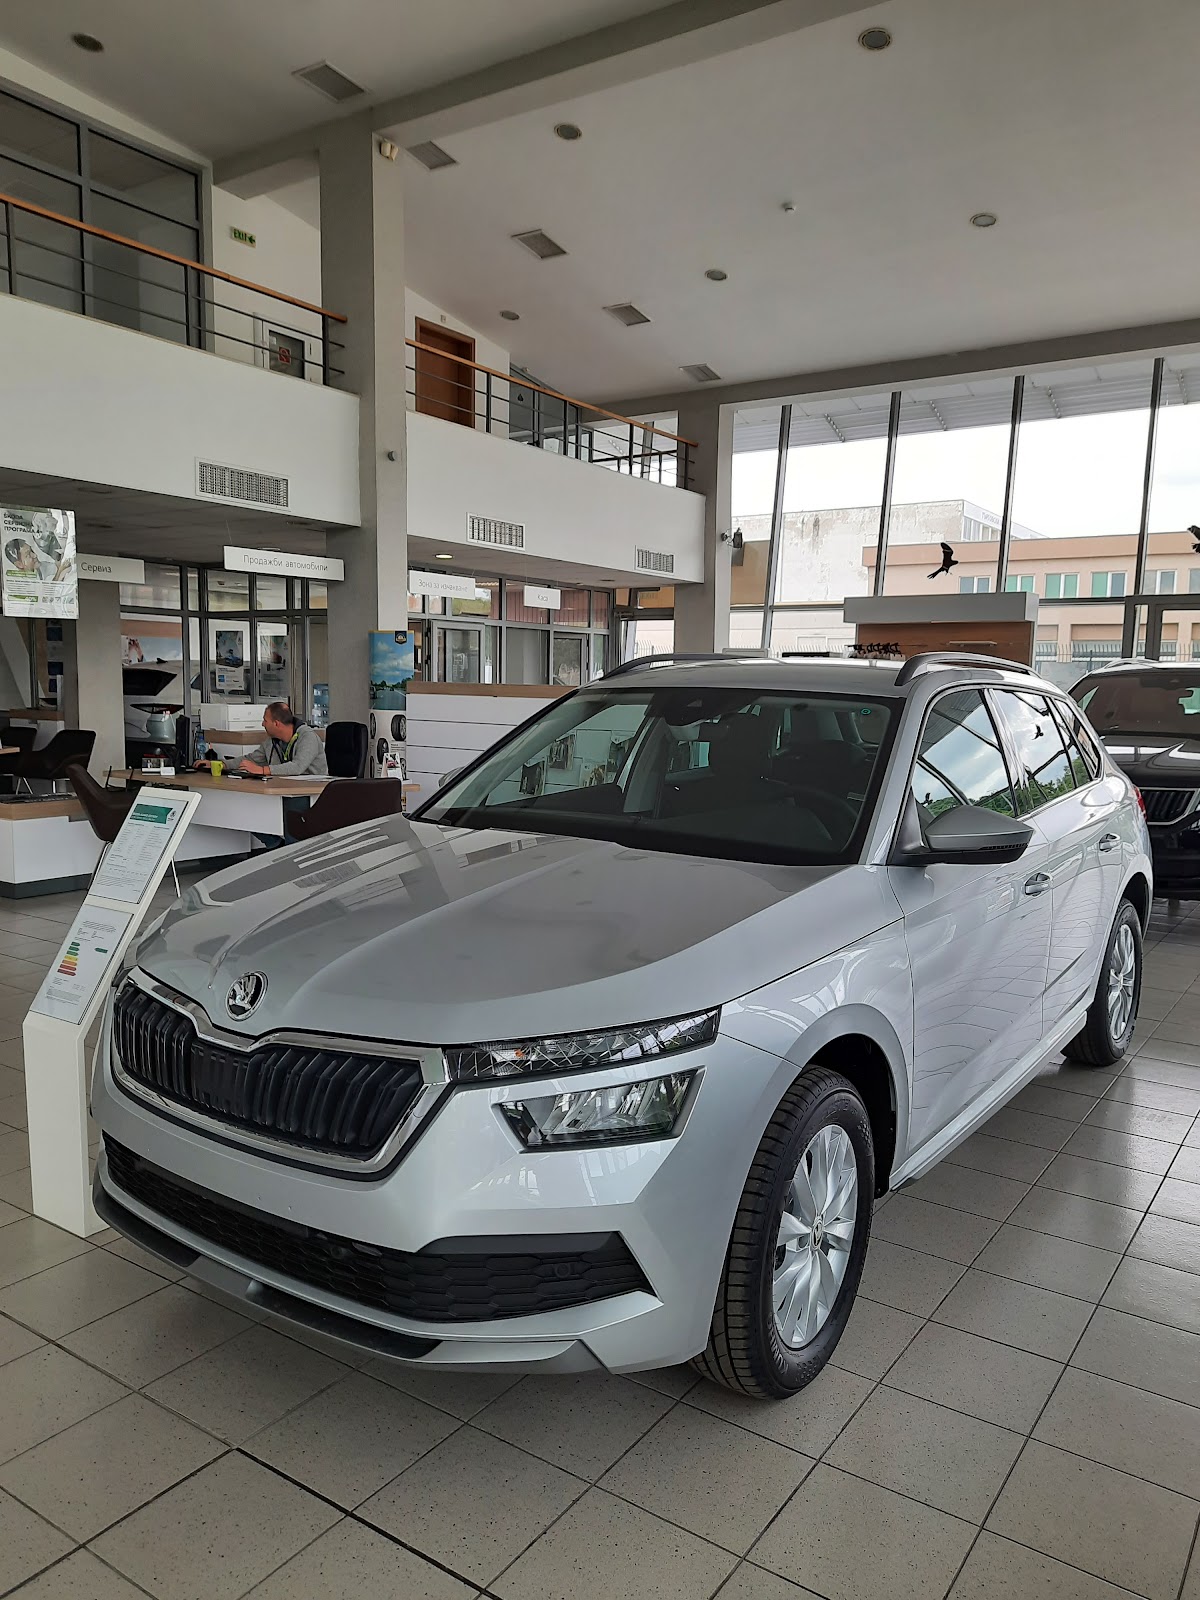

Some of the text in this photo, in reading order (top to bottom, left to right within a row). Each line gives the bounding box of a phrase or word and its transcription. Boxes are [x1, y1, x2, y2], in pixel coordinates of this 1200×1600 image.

[80, 561, 112, 574] Сервиз
[243, 554, 329, 572] Продажби автомобили
